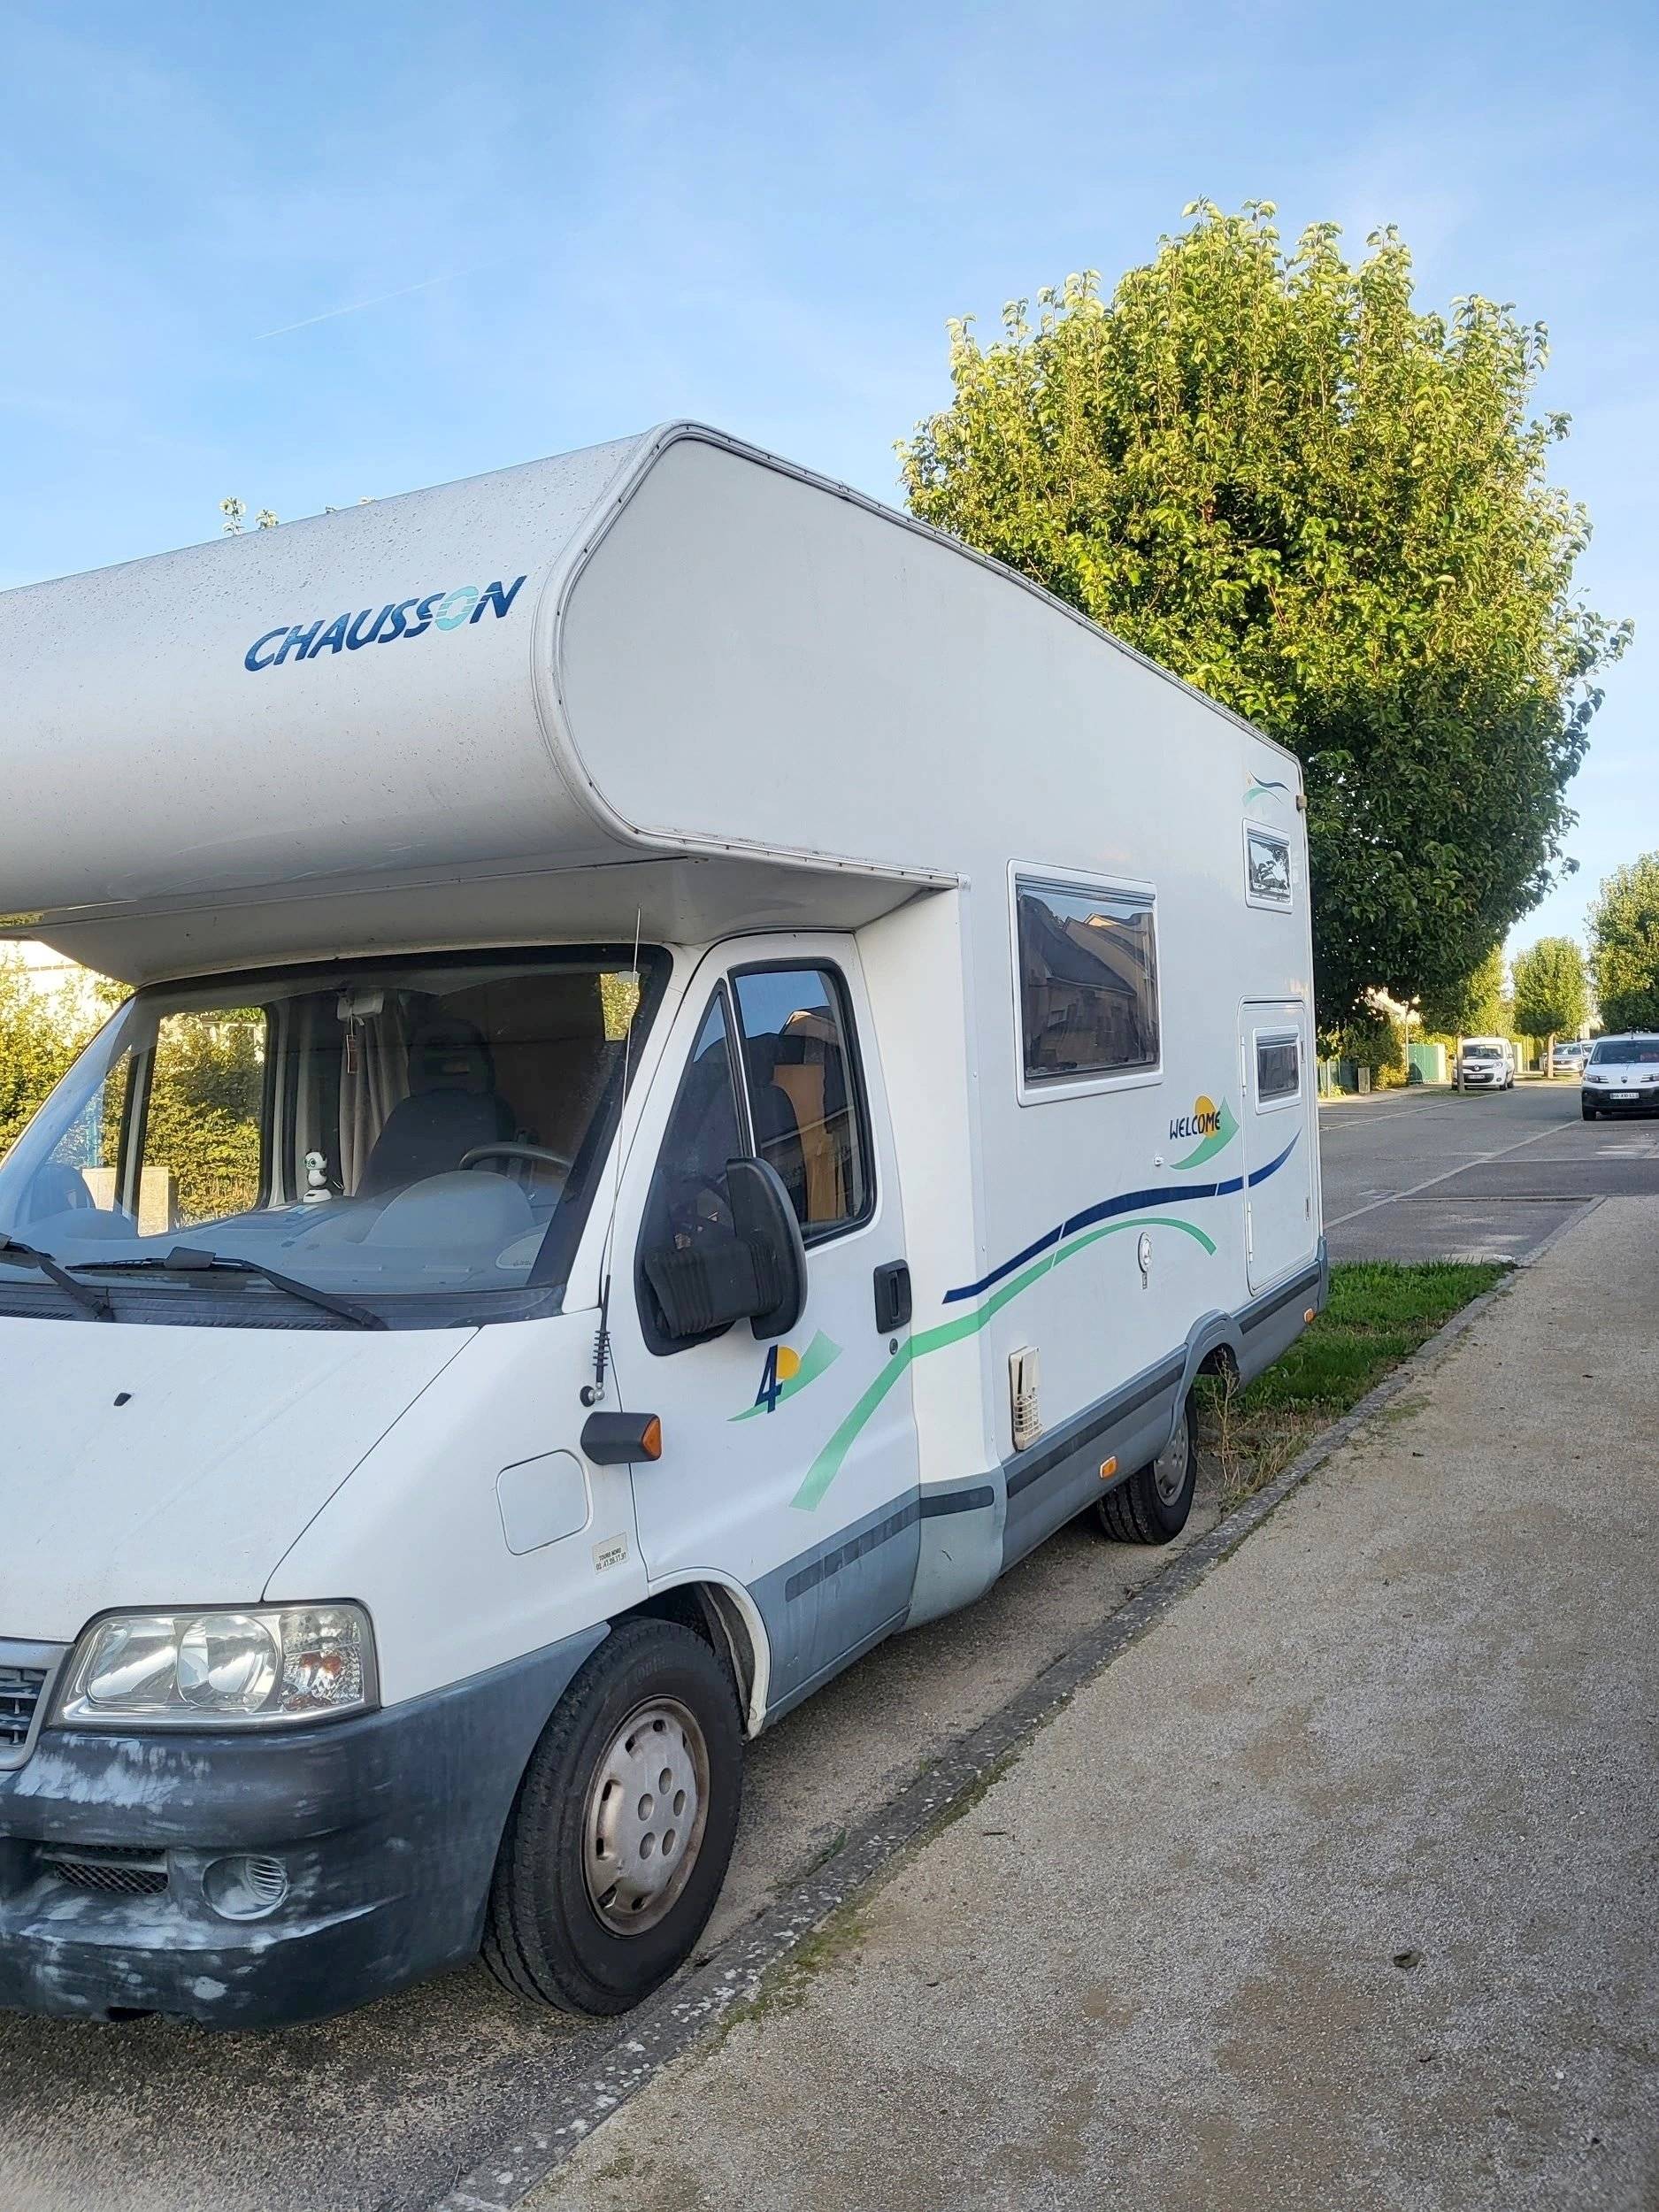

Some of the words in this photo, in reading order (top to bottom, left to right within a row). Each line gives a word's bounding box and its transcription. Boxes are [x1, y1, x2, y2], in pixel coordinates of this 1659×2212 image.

[243, 575, 527, 672] CHAUSSON
[1169, 1110, 1221, 1140] WELCOME
[754, 1344, 783, 1414] 4
